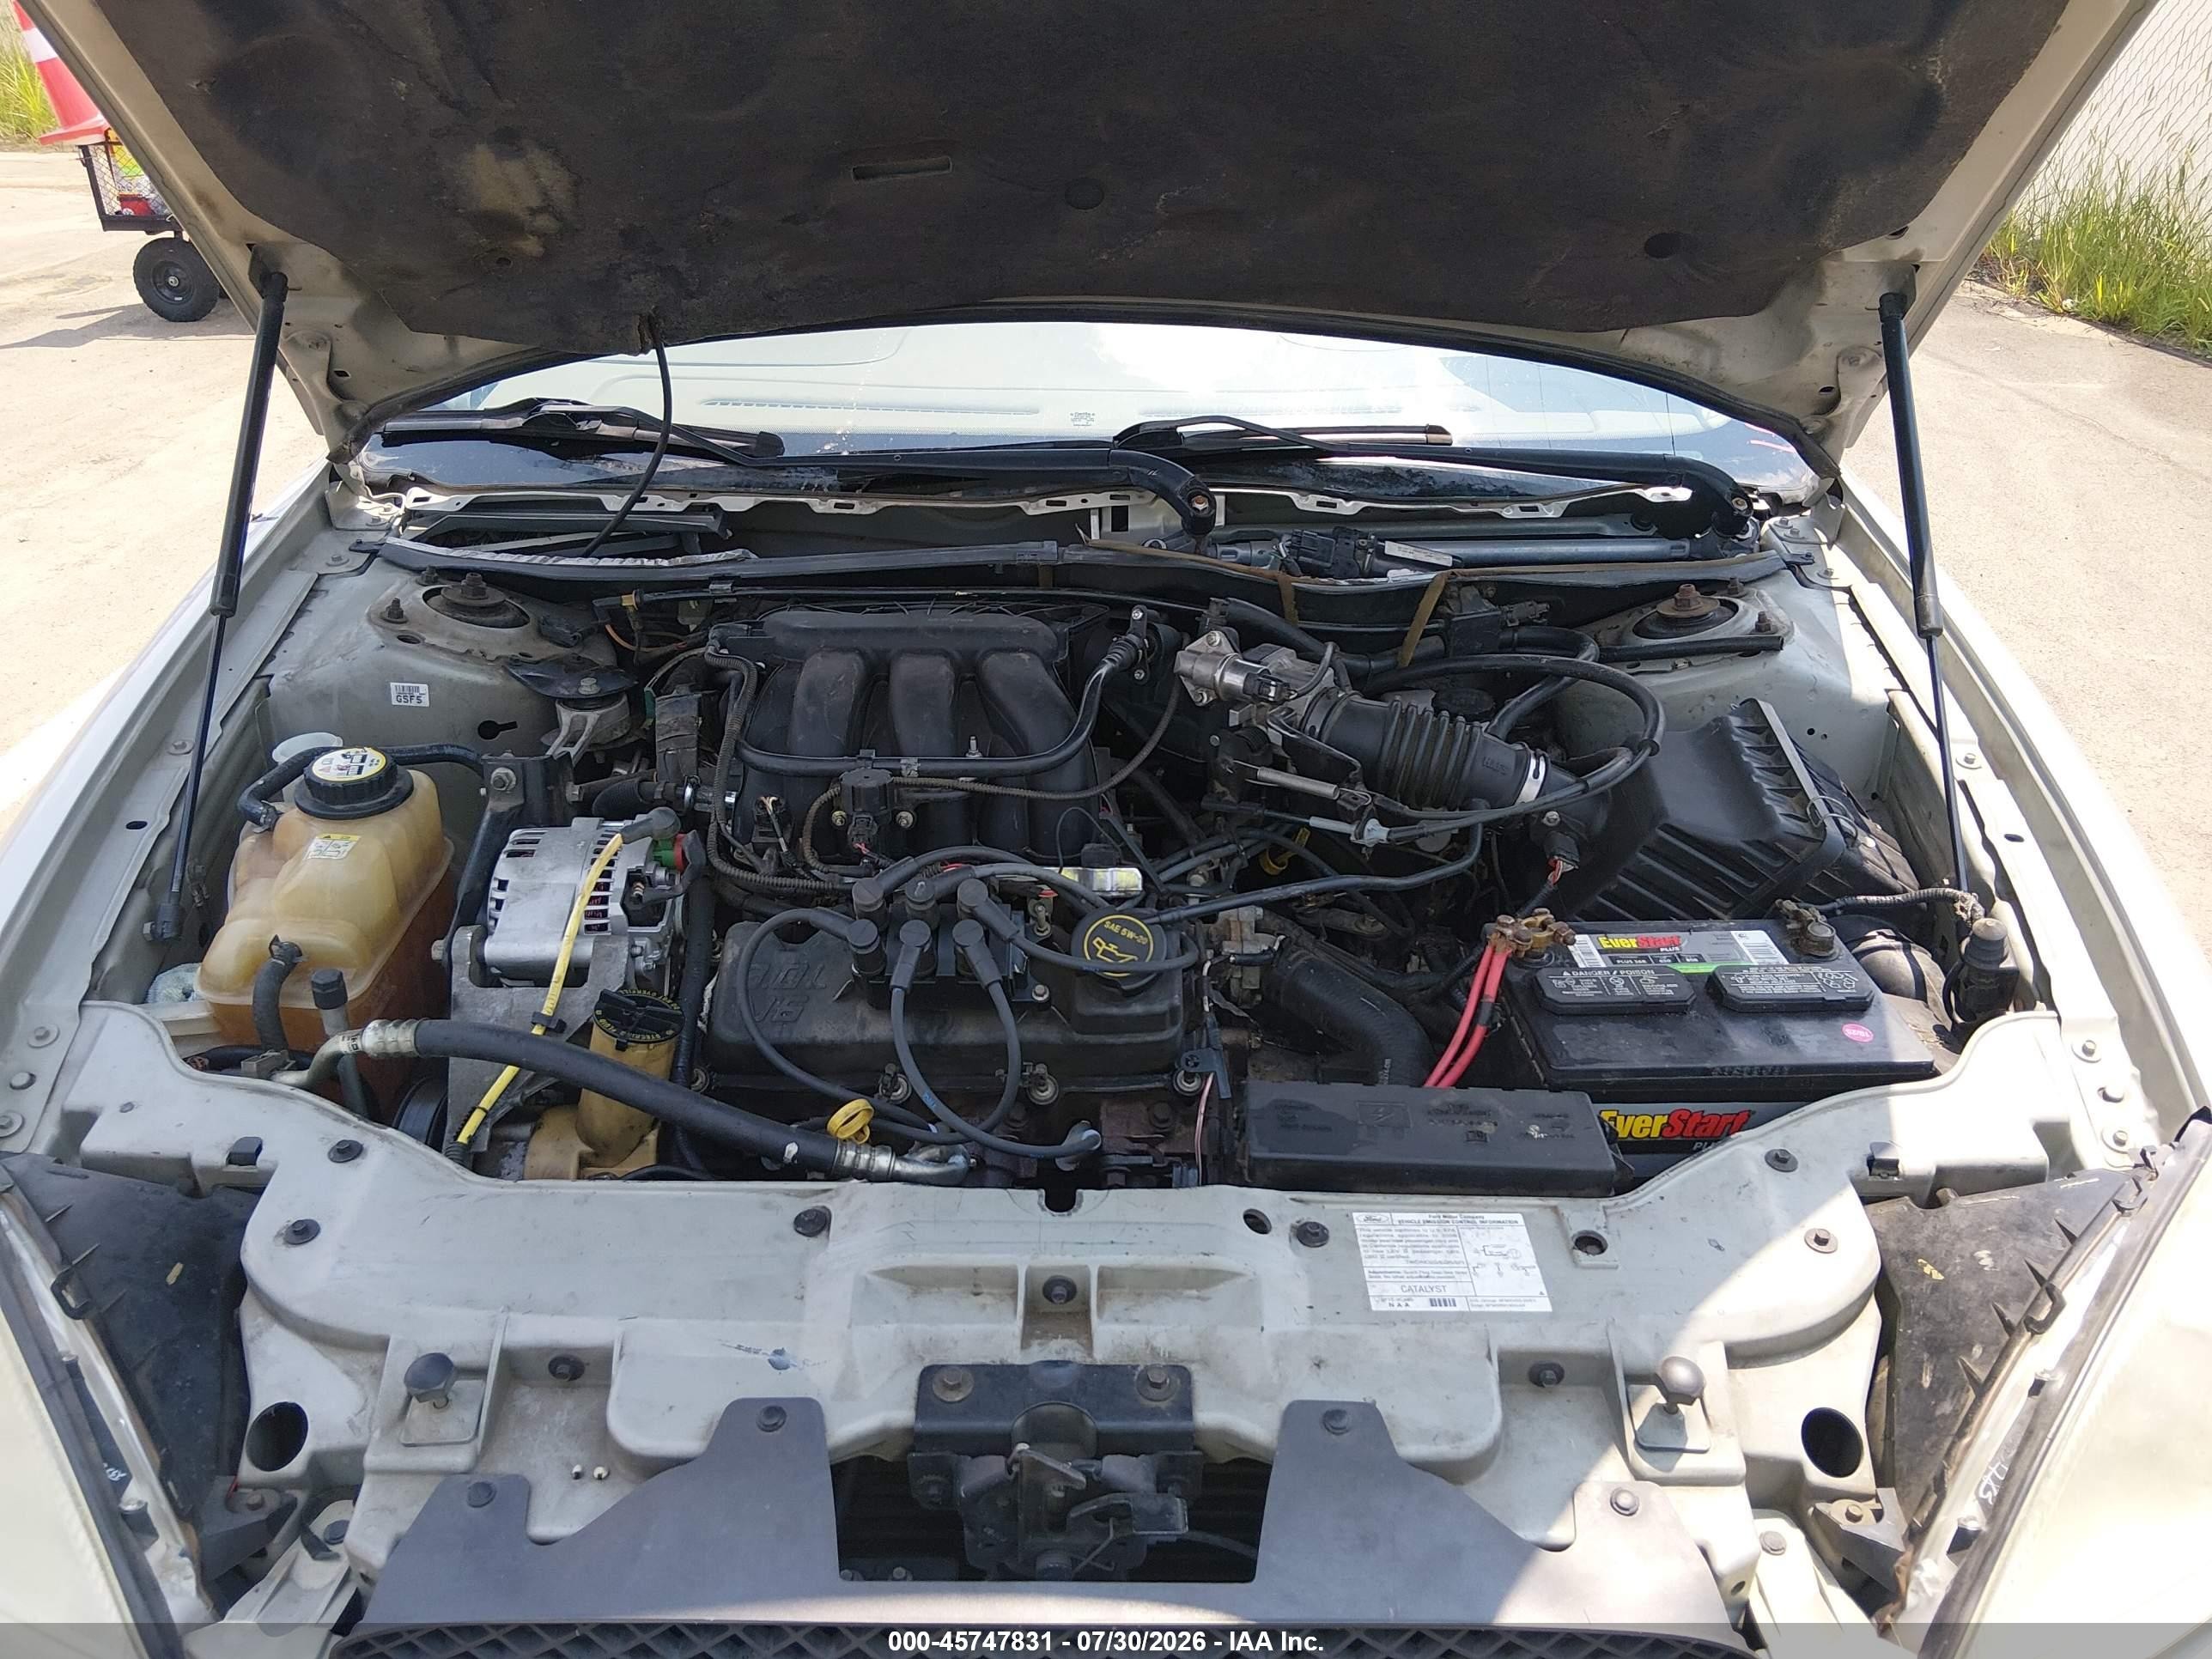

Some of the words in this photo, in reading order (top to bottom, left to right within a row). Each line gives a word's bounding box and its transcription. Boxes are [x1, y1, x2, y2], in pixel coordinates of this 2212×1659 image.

[396, 695, 422, 704] GSF5
[1103, 921, 1121, 933] SAE
[1598, 933, 1681, 949] EverStart
[1601, 1109, 1752, 1139] EverStart
[1401, 1285, 1447, 1293] CATALYST
